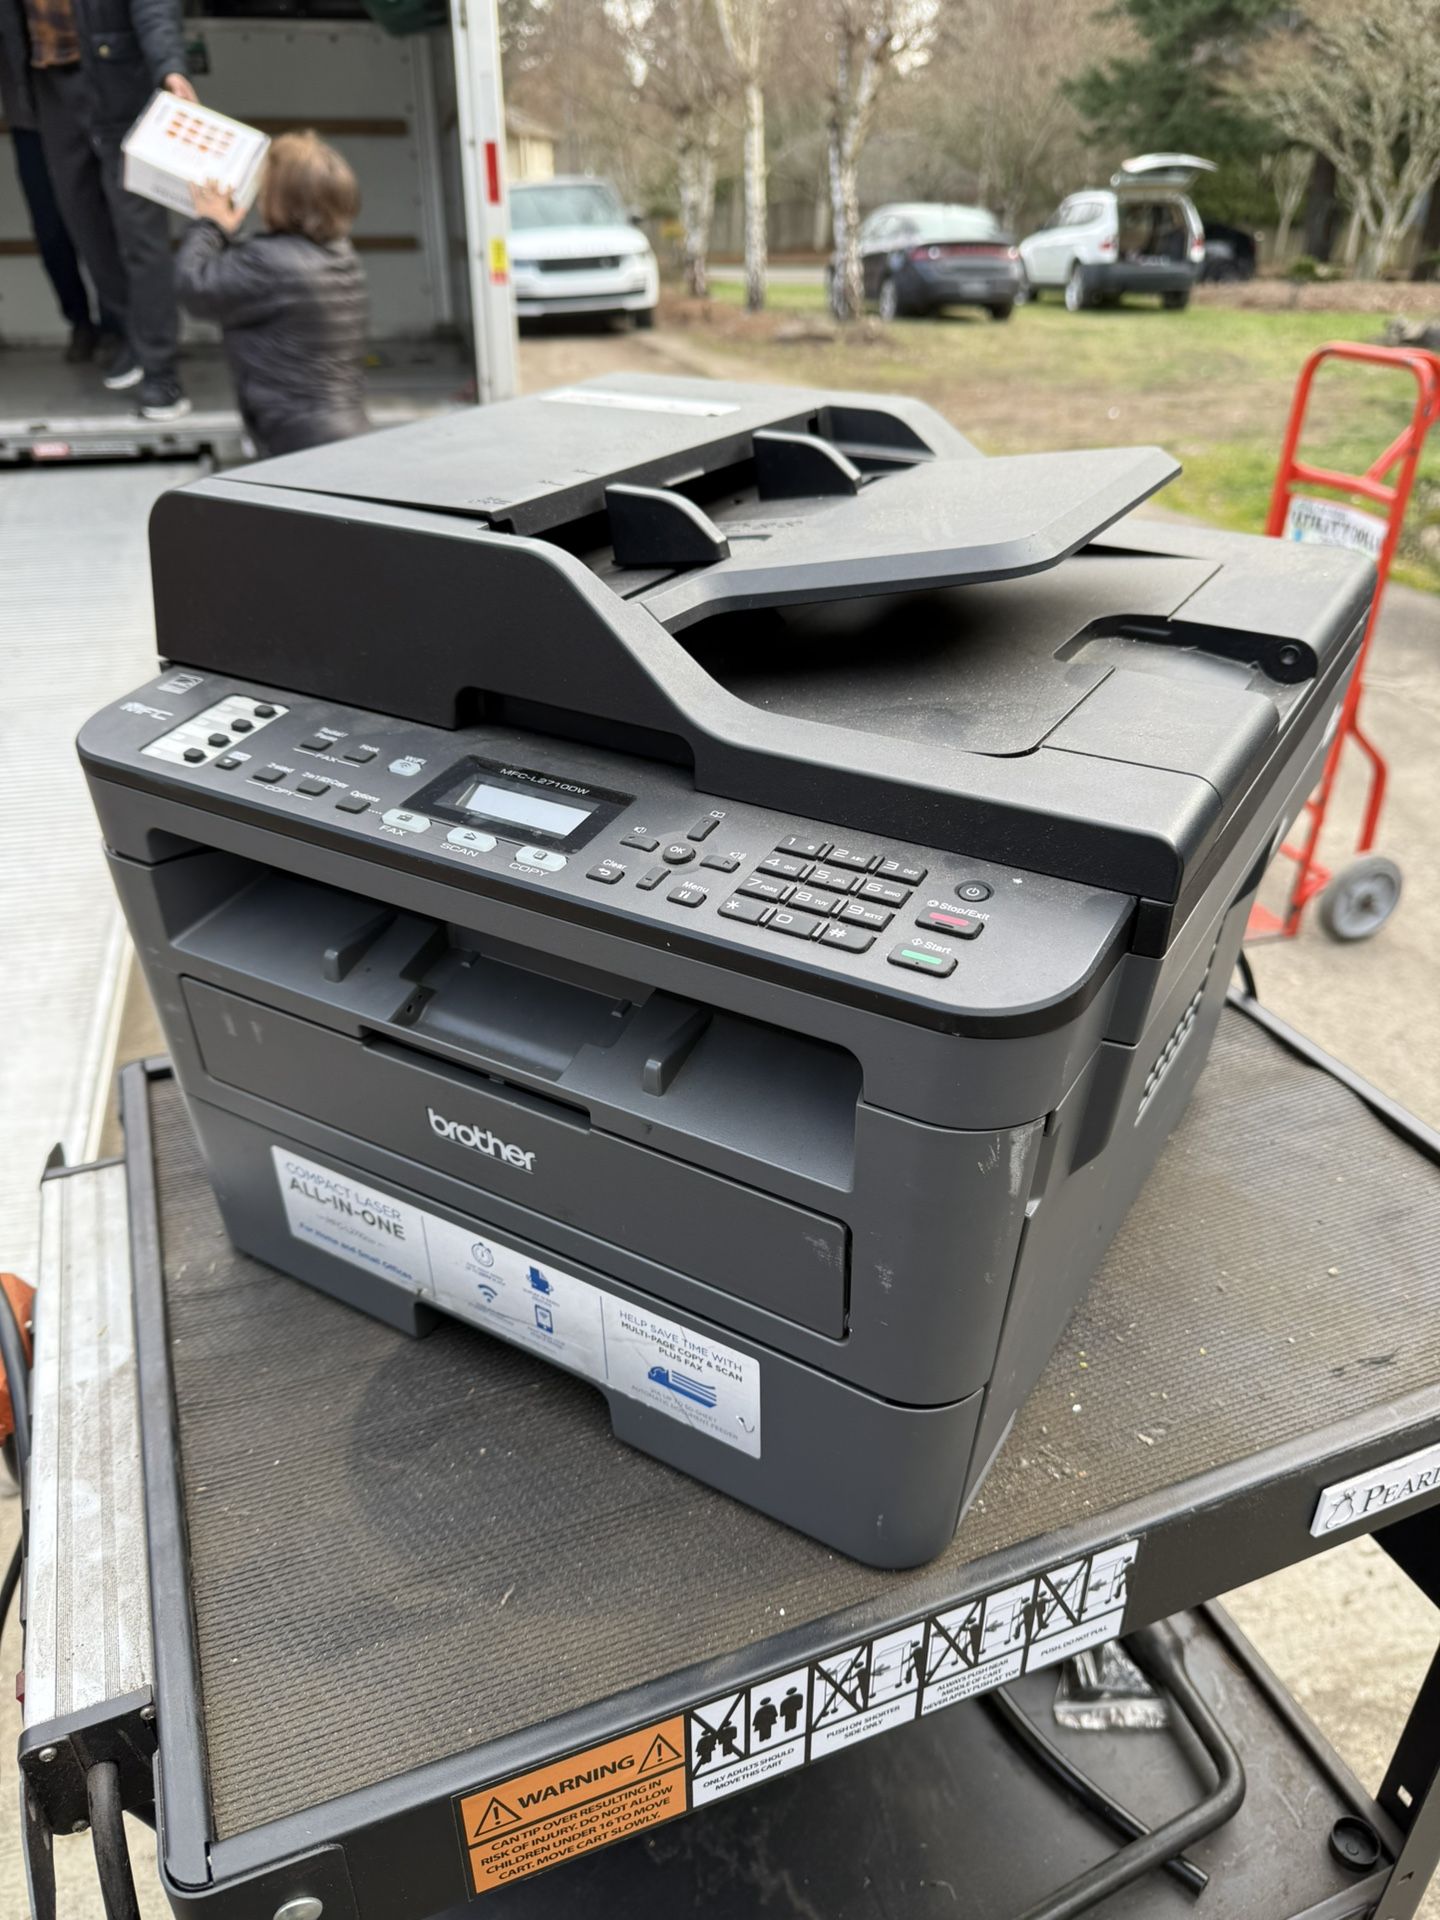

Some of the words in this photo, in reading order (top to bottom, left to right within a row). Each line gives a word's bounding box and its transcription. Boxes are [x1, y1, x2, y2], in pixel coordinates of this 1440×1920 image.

[314, 753, 338, 763] FAX
[264, 784, 293, 795] COPY
[500, 768, 590, 795] MFC-L2710DW
[350, 790, 380, 802] Options
[378, 824, 406, 837] FAX
[788, 837, 797, 846] 1
[440, 843, 479, 858] SCAN
[669, 846, 686, 855] OK
[833, 849, 849, 858] 2
[851, 855, 865, 863] ABC
[509, 862, 549, 877] COPY
[603, 859, 627, 870] Clear
[765, 858, 780, 867] 4
[883, 861, 900, 871] 3
[903, 868, 919, 876] DEF
[747, 879, 762, 888] 7
[815, 870, 831, 880] 5
[833, 877, 846, 885] JKL
[682, 881, 710, 893] Menu
[866, 883, 883, 892] 6
[884, 889, 901, 897] MNO
[796, 892, 812, 901] 8
[775, 914, 793, 924] 0
[847, 905, 864, 915] 9
[864, 912, 884, 921] WXYZ
[939, 902, 990, 921] Stop/Exit
[924, 941, 952, 954] Start
[427, 1107, 536, 1170] brother
[286, 1162, 350, 1197] COMPACT
[355, 1193, 401, 1220] LASER
[290, 1178, 406, 1241] ALL-IN-ONE
[619, 1310, 647, 1327] HELP
[650, 1324, 679, 1343] SAVE
[682, 1338, 708, 1357] TIME
[711, 1351, 742, 1372] WITH
[621, 1321, 676, 1350] MULTI-PAGE
[677, 1347, 704, 1365] COPY
[715, 1364, 743, 1382] SCAN
[659, 1346, 682, 1362] PLUS
[684, 1360, 703, 1373] FAX
[1091, 1625, 1107, 1637] PULL
[937, 1674, 967, 1691] ALWAYS
[968, 1667, 988, 1679] PUSH
[989, 1659, 1009, 1672] NEAR
[941, 1681, 970, 1697] MIDDLE
[972, 1676, 981, 1685] OF
[983, 1668, 1002, 1680] CART
[923, 1697, 948, 1711] NEVER
[949, 1688, 973, 1702] APPLY
[973, 1679, 992, 1692] PUSH
[994, 1673, 1004, 1682] AT
[826, 1725, 849, 1738] PUSH
[850, 1720, 862, 1730] ON
[864, 1705, 900, 1723] SHORTER
[844, 1727, 861, 1739] SIDE
[863, 1719, 883, 1731] ONLY
[703, 1774, 726, 1788] ONLY
[727, 1762, 760, 1779] ADULTS
[760, 1747, 794, 1765] SHOULD
[715, 1777, 741, 1790] MOVE
[741, 1770, 760, 1780] THIS
[761, 1760, 783, 1772] CART
[518, 1754, 635, 1809] WARNING
[491, 1834, 520, 1850] CAN
[521, 1826, 541, 1839] TIP
[543, 1812, 578, 1831] OVER
[580, 1785, 647, 1817] RESULTING
[649, 1779, 662, 1790] IN
[481, 1849, 510, 1866] RISK
[512, 1841, 529, 1854] OF
[532, 1823, 578, 1846] INJURY.
[580, 1815, 599, 1827] DO
[602, 1804, 628, 1819] NOT
[630, 1784, 673, 1808] ALLOW
[486, 1844, 551, 1875] CHILDREN
[553, 1826, 597, 1848] UNDER
[600, 1819, 614, 1830] 16
[616, 1812, 631, 1824] TO
[634, 1796, 671, 1816] MOVE
[499, 1861, 535, 1880] CART.
[536, 1845, 575, 1865] MOVE
[577, 1831, 609, 1849] CART
[611, 1811, 661, 1836] SLOWLY.
